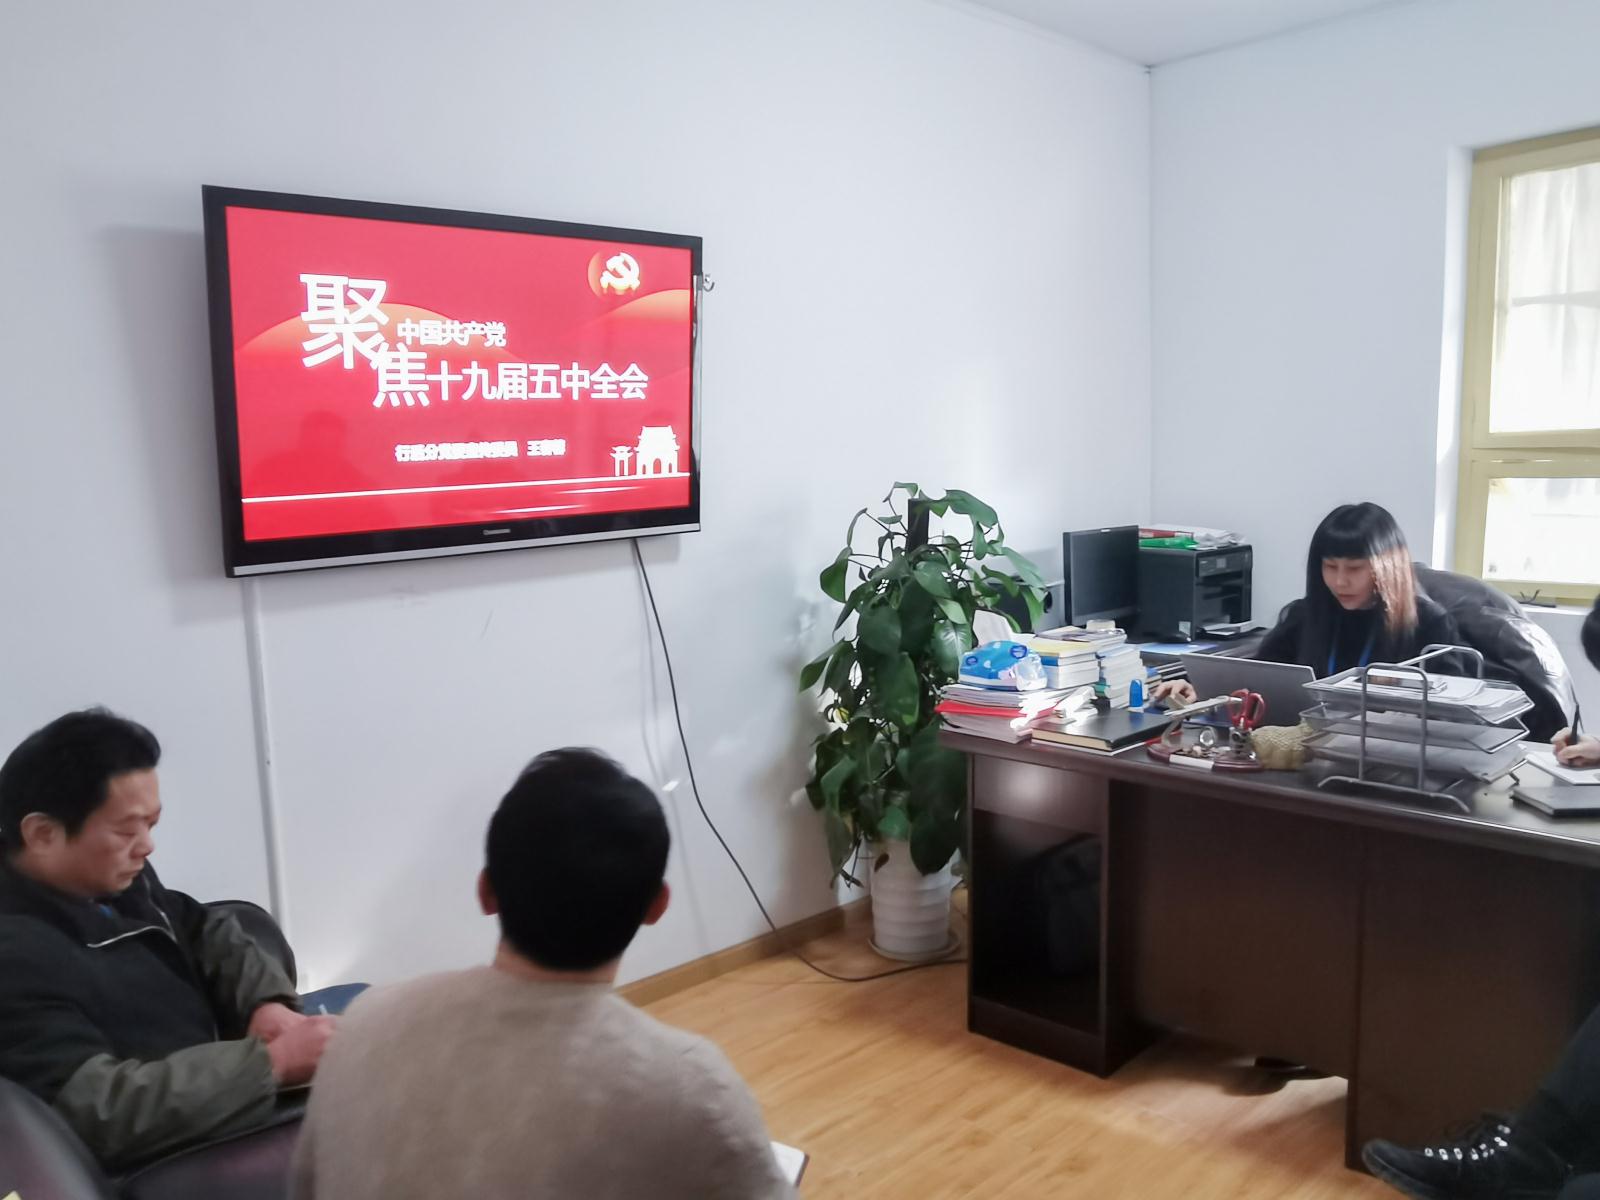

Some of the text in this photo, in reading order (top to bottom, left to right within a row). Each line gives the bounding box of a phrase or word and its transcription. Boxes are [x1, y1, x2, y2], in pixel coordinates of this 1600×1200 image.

[299, 273, 389, 370] 聚
[396, 317, 507, 350] 中国共产党
